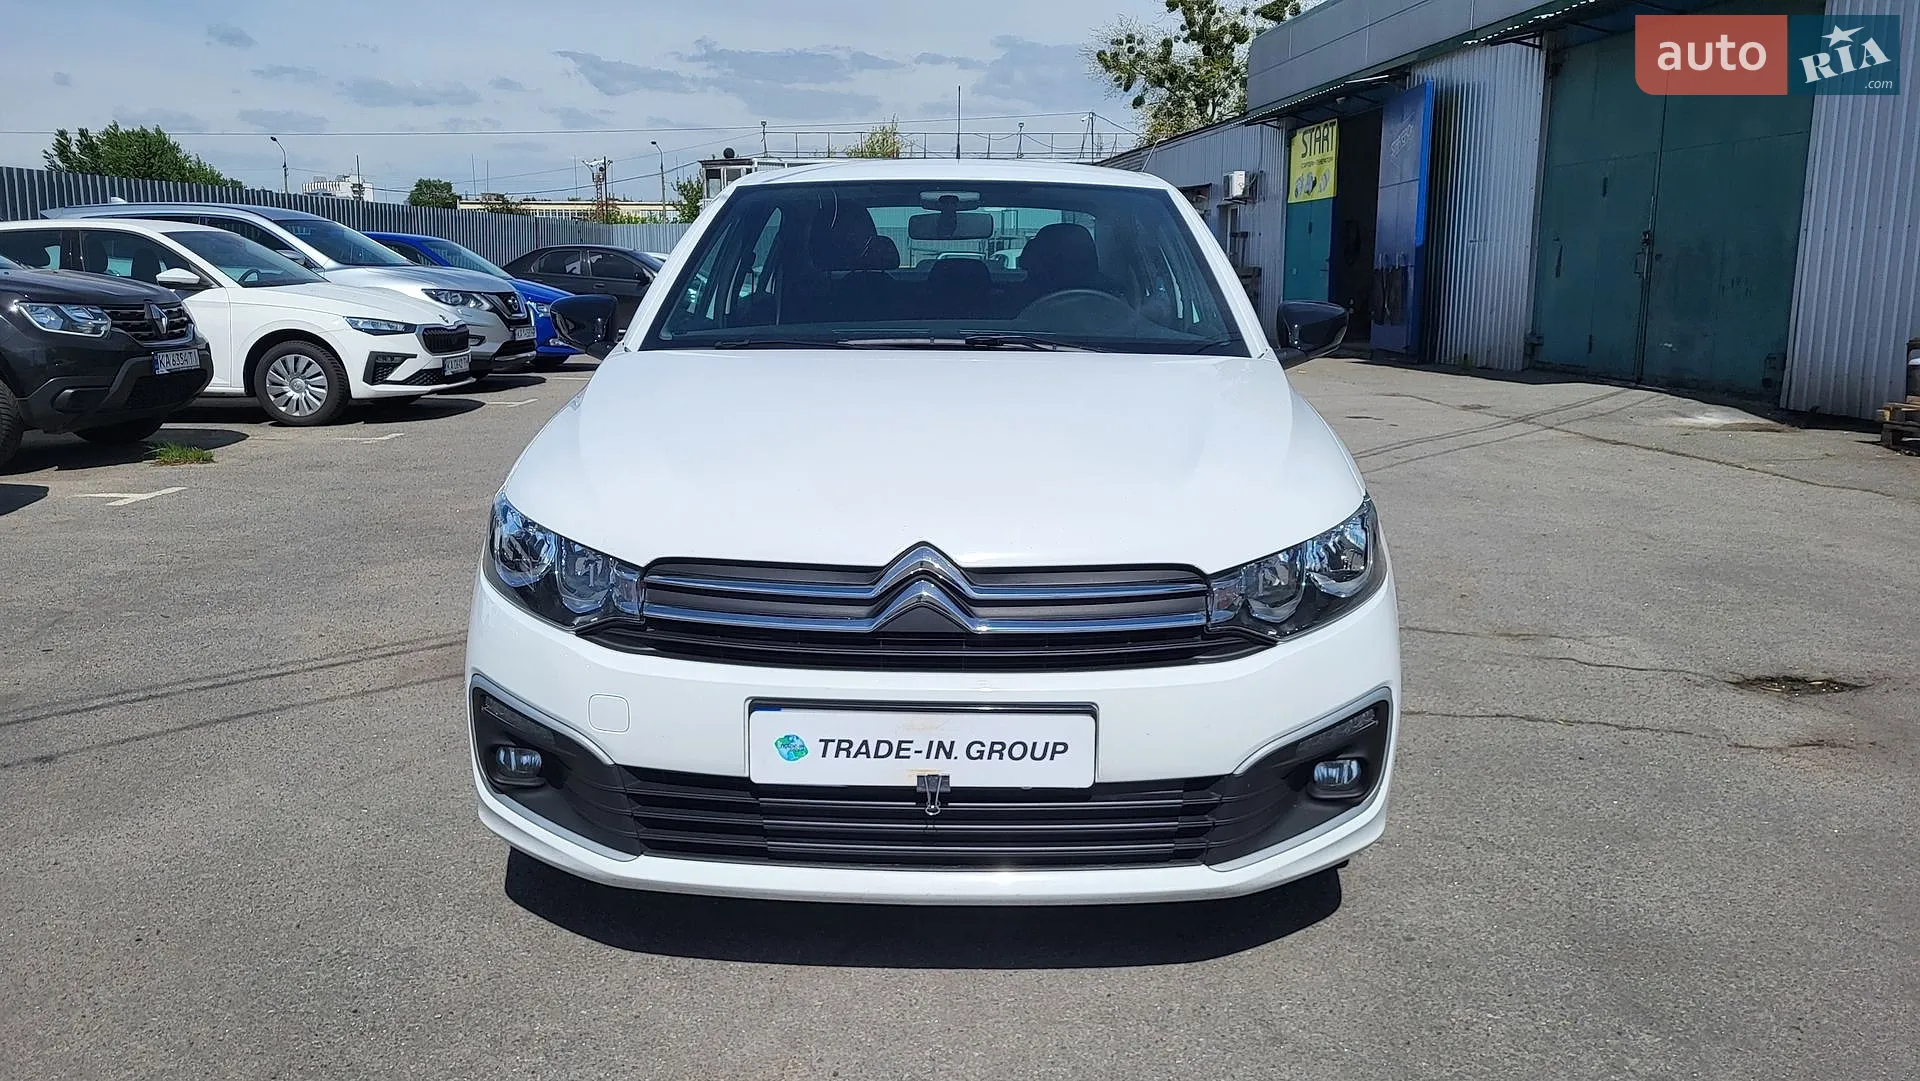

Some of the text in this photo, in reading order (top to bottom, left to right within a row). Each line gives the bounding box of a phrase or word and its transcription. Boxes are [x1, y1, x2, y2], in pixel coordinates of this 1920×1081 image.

[1301, 121, 1337, 159] START
[818, 738, 958, 760] TRADE-IN.
[965, 740, 1069, 761] GROUP
